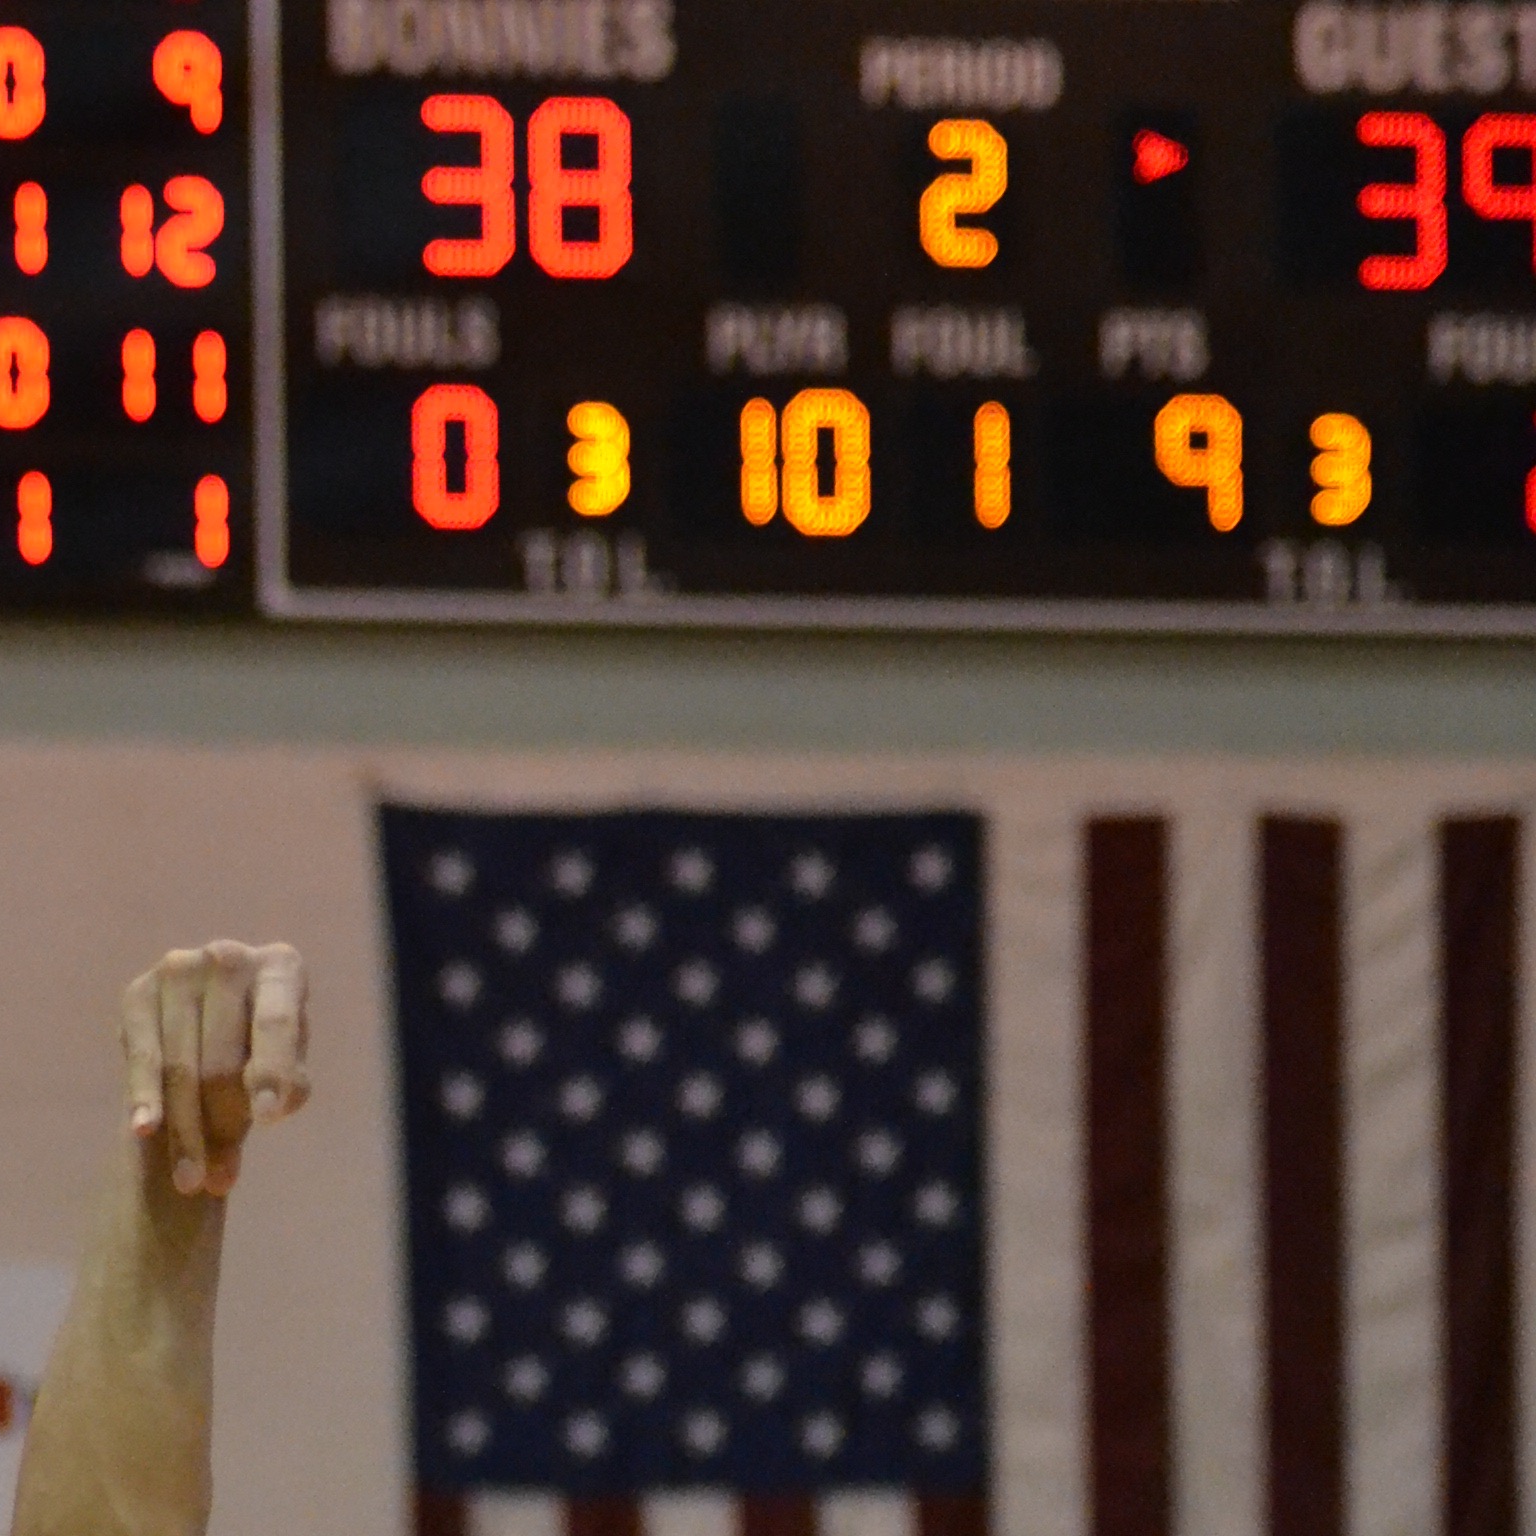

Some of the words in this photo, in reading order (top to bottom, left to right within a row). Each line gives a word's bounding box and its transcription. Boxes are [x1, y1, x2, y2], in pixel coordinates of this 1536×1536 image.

[153, 30, 222, 134] 9
[328, 0, 676, 78] BONNIES
[860, 38, 1062, 107] PERIOD
[14, 182, 48, 275] 1
[120, 175, 224, 288] 12
[421, 94, 633, 279] 38
[918, 119, 1008, 268] 2
[1358, 112, 1536, 290] 39
[122, 328, 227, 423] 11
[315, 298, 500, 367] FOULS
[891, 307, 1034, 377] FOUL
[1100, 308, 1208, 379] PTS
[412, 384, 500, 531] 0
[567, 401, 631, 517] 3
[740, 389, 870, 537] 10
[974, 401, 1011, 529] 1
[1155, 394, 1243, 532] 9
[1310, 413, 1372, 526] 3
[17, 471, 52, 565] 1
[195, 474, 229, 568] 1
